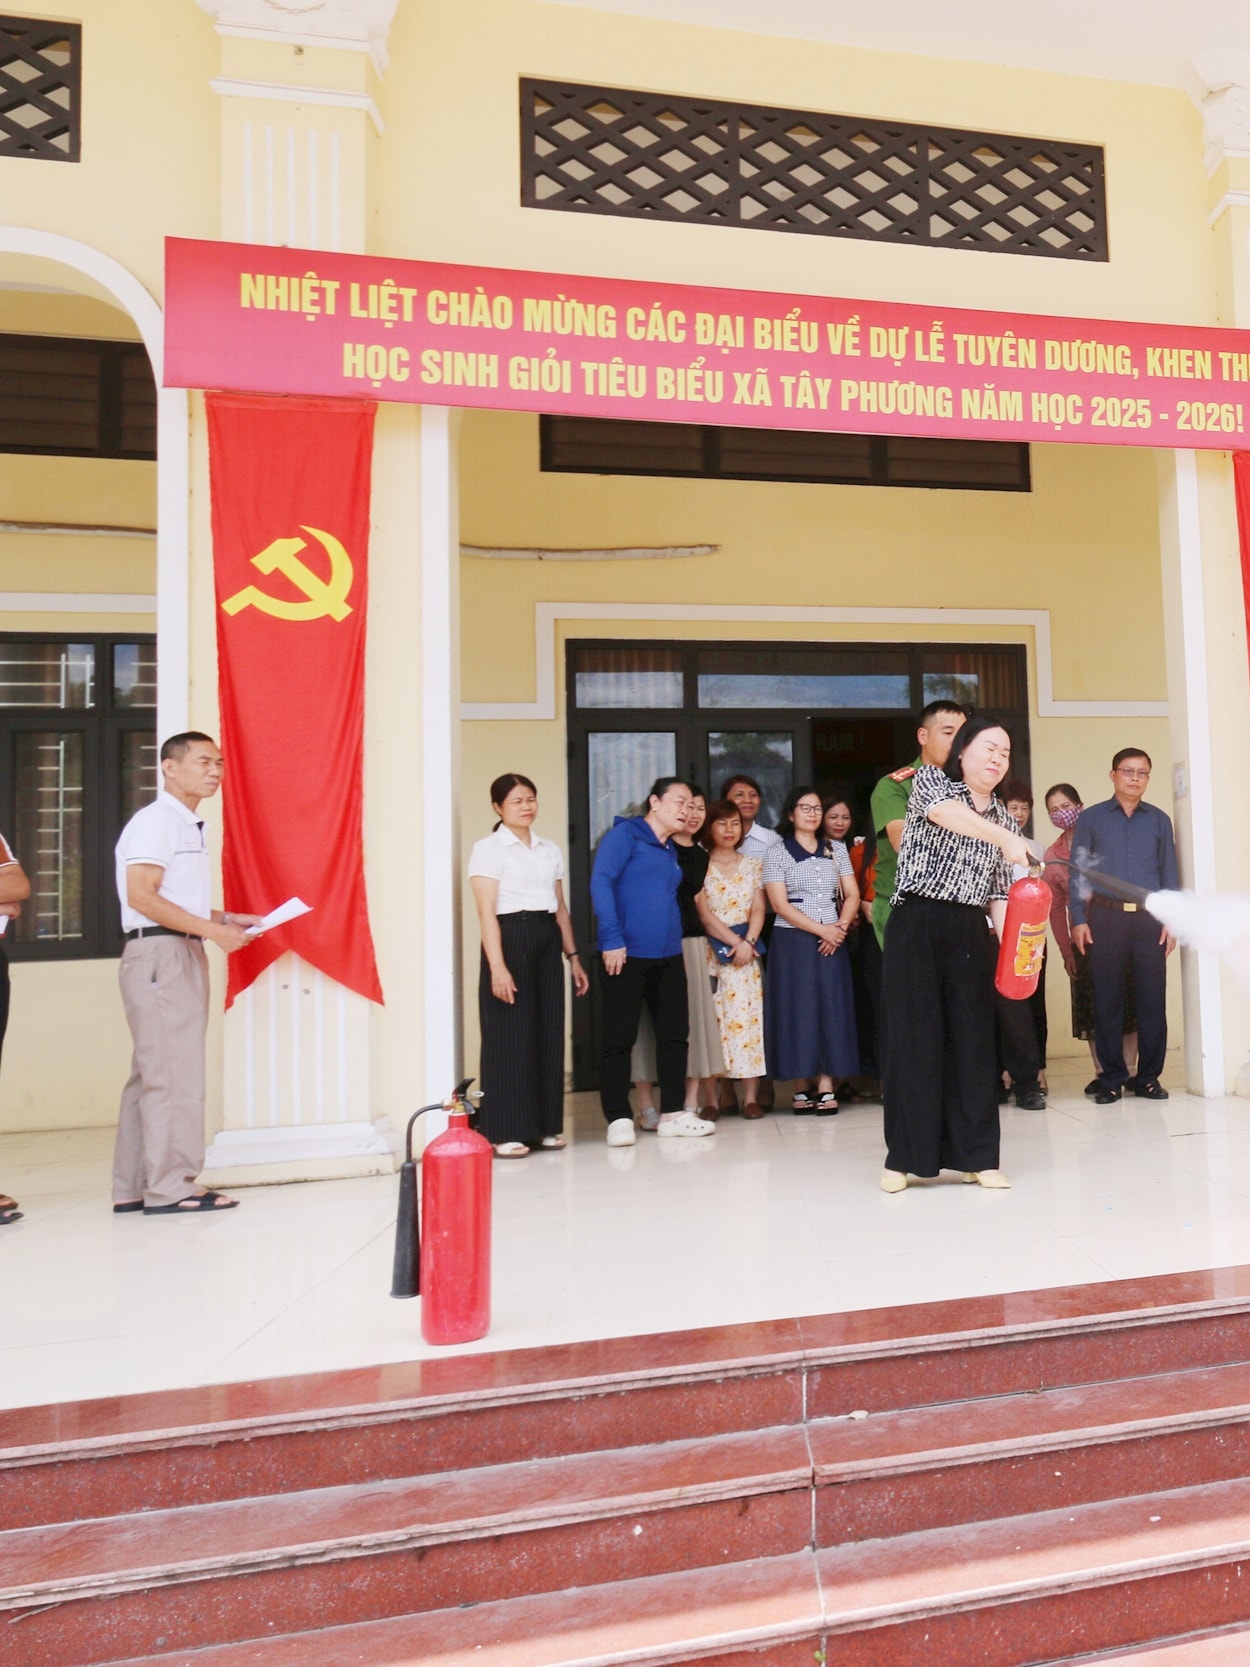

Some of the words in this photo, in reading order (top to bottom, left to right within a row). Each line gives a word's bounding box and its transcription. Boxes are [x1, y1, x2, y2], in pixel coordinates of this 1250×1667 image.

[240, 271, 340, 321] NHIỆT
[350, 279, 418, 327] LIỆT
[427, 286, 513, 330] CHÀO
[523, 294, 617, 339] MỪNG
[627, 302, 687, 343] CÁC
[695, 312, 745, 355] ĐẠI
[753, 307, 819, 353] BIỂU
[827, 314, 861, 358] VỀ
[869, 326, 910, 367] DỰ
[914, 320, 946, 364] LỄ
[953, 330, 1037, 370] TUYÊN
[1044, 339, 1139, 379] DƯƠNG,
[1146, 347, 1213, 380] KHEN
[343, 342, 410, 388] HỌC
[420, 349, 499, 388] SINH
[508, 347, 572, 393] GIỎI
[580, 357, 647, 400] TIÊU
[656, 356, 724, 404] BIỂU
[733, 367, 773, 406] XÃ
[780, 370, 832, 410] TÂY
[840, 379, 953, 418] PHƯƠNG
[961, 383, 1024, 421] NĂM
[1031, 392, 1083, 431] HỌC
[1090, 396, 1152, 428] 2025
[1176, 400, 1245, 433] 2026!
